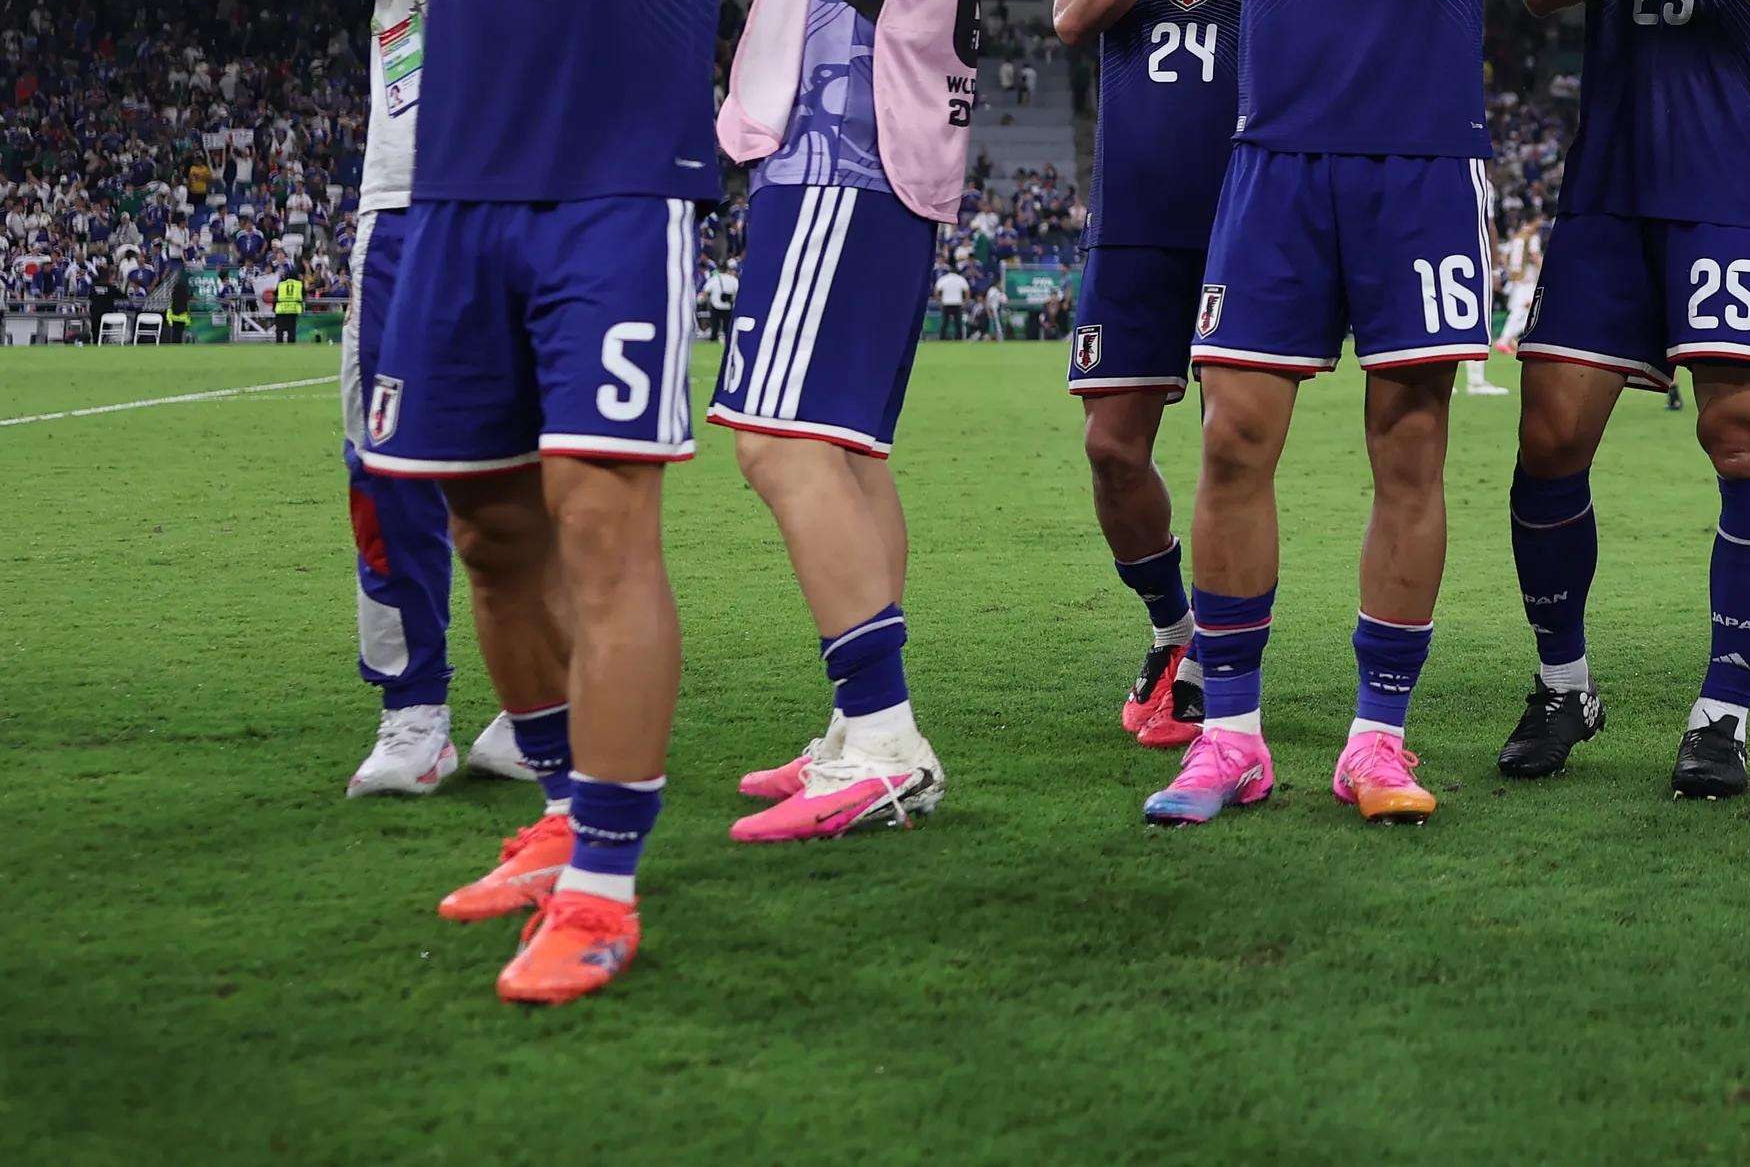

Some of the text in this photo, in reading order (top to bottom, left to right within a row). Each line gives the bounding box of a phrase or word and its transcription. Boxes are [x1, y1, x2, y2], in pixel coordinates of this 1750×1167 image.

[1148, 22, 1218, 83] 24
[1412, 254, 1479, 334] 16
[596, 322, 656, 421] 5
[1525, 590, 1568, 605] PAN
